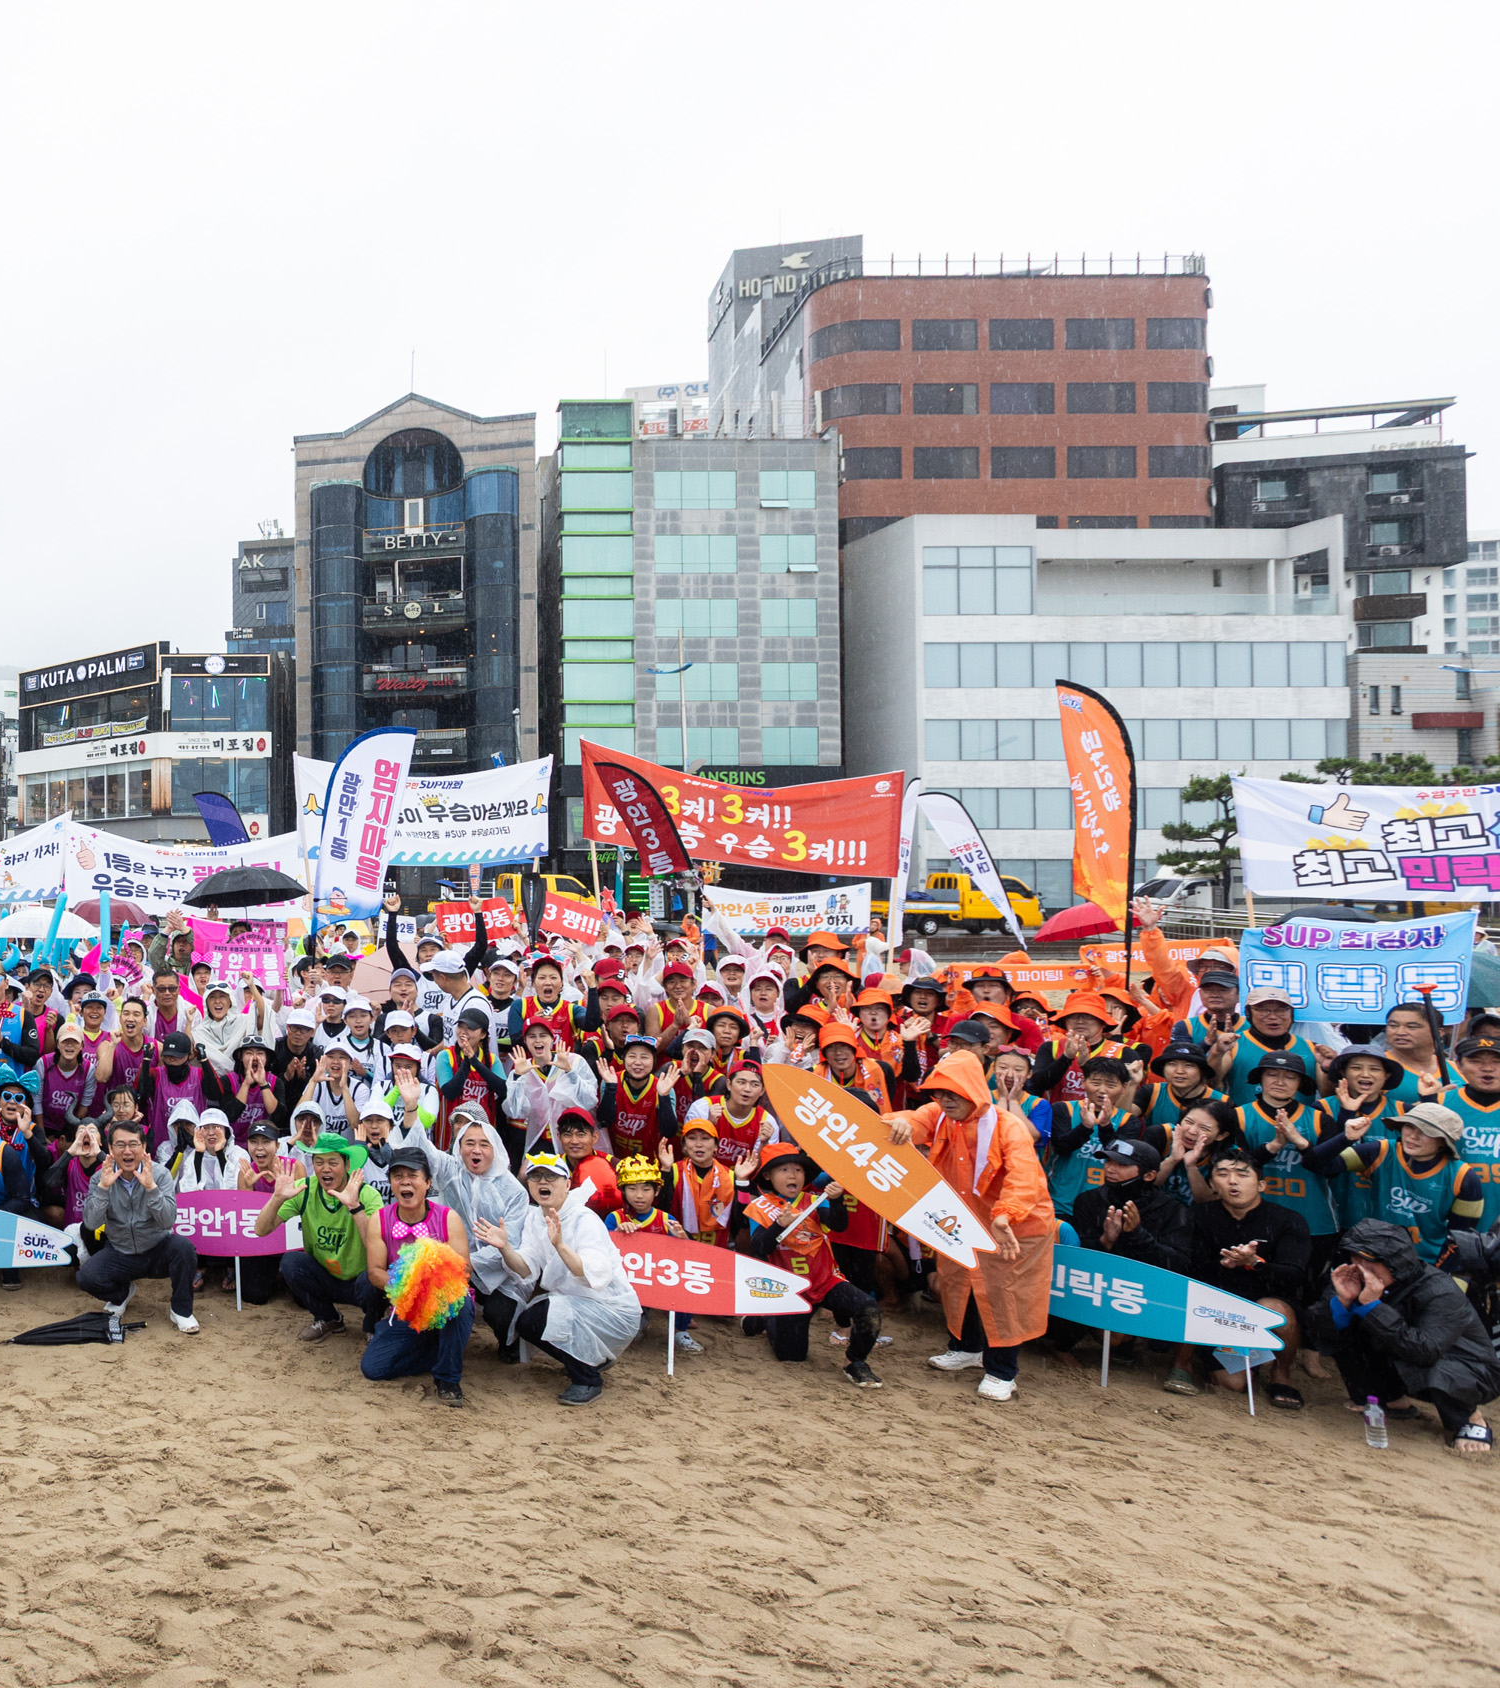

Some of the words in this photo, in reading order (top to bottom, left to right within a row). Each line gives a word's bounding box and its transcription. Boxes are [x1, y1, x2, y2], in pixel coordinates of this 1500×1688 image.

[739, 275, 796, 297] HOND
[385, 533, 442, 550] BETTY
[238, 553, 265, 569] AK
[40, 668, 75, 689] KUTA
[88, 656, 126, 679] PALM
[376, 677, 429, 692] Waltz
[213, 737, 254, 751] 미포집
[330, 771, 362, 861] 광안1동
[355, 757, 401, 893] 엄지마을
[612, 777, 675, 876] 광안3동
[1381, 812, 1490, 853] 최고
[714, 832, 775, 859] 우승
[782, 830, 867, 866] 3켜!!!
[103, 852, 146, 876] 1등은
[150, 865, 188, 880] 누구?
[1292, 848, 1397, 887] 최고
[91, 873, 149, 899] 우승은
[827, 914, 853, 927] 하지
[1260, 924, 1333, 949] SUP
[1338, 923, 1448, 951] 최강자
[1016, 969, 1064, 982] 파이팅!
[463, 1078, 489, 1104] Sup
[617, 1110, 645, 1136] Sup
[794, 1087, 909, 1192] 광안4동
[1264, 1176, 1306, 1198] 20
[174, 1207, 263, 1238] 광안1동
[921, 1219, 936, 1232] SURF
[934, 1230, 954, 1248] MARINE
[23, 1234, 56, 1249] SUPer
[317, 1226, 347, 1254] Sup
[18, 1248, 58, 1262] POWER
[790, 1257, 810, 1275] 5
[620, 1252, 715, 1295] 안3동
